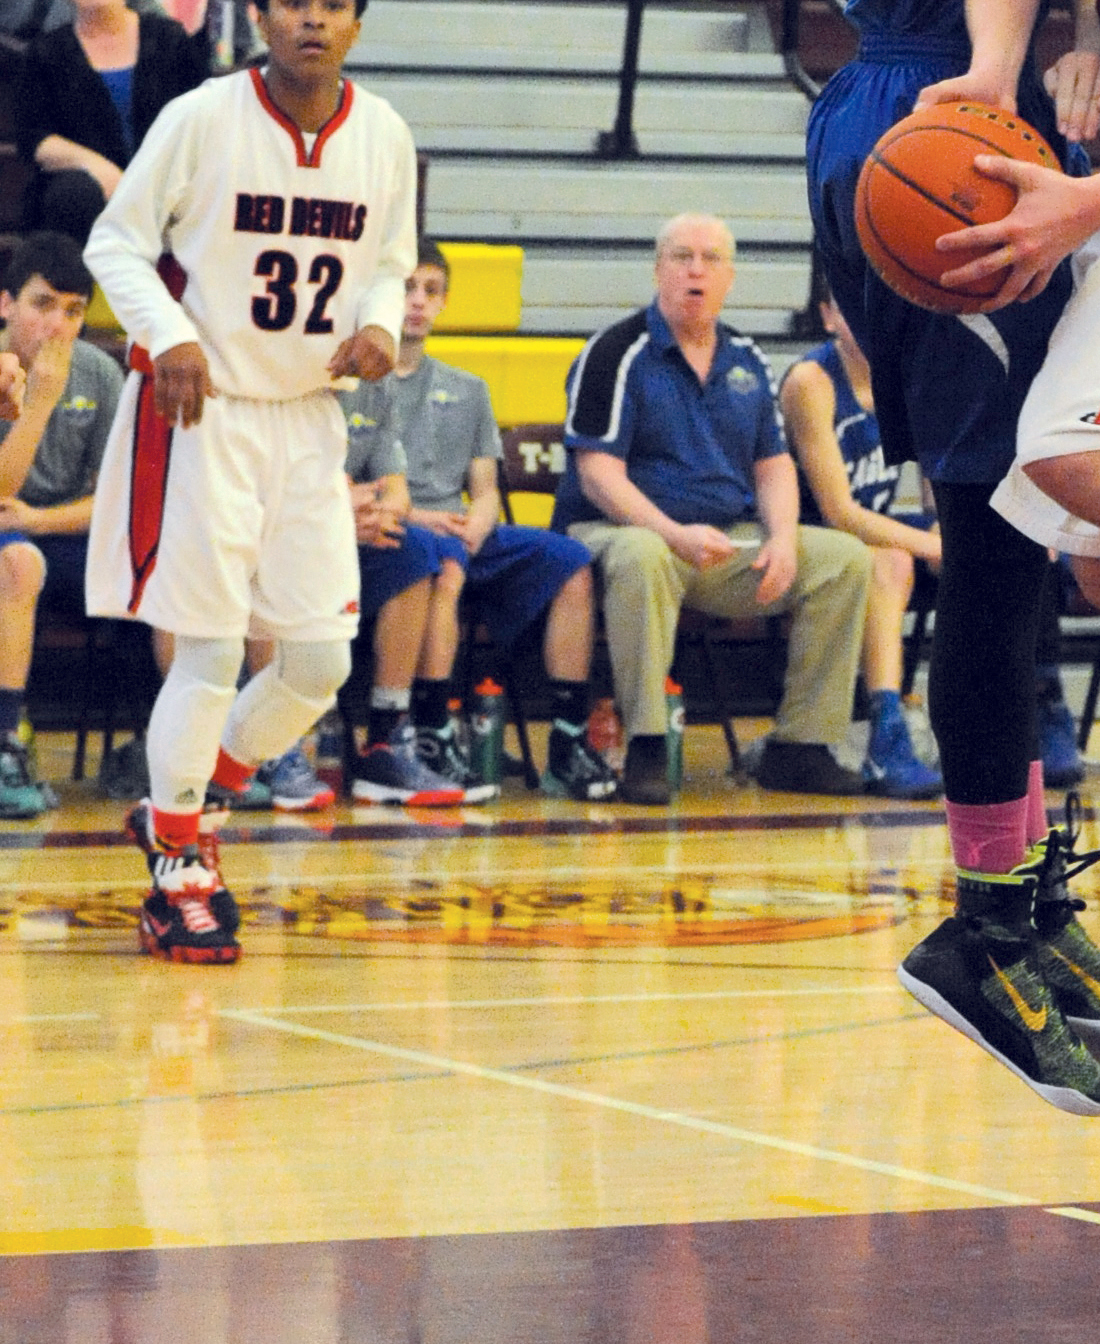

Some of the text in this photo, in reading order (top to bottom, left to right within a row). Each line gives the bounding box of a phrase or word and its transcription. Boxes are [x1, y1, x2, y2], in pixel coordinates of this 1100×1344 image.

[234, 193, 367, 242] RED DEVILS
[251, 249, 344, 334] 32
